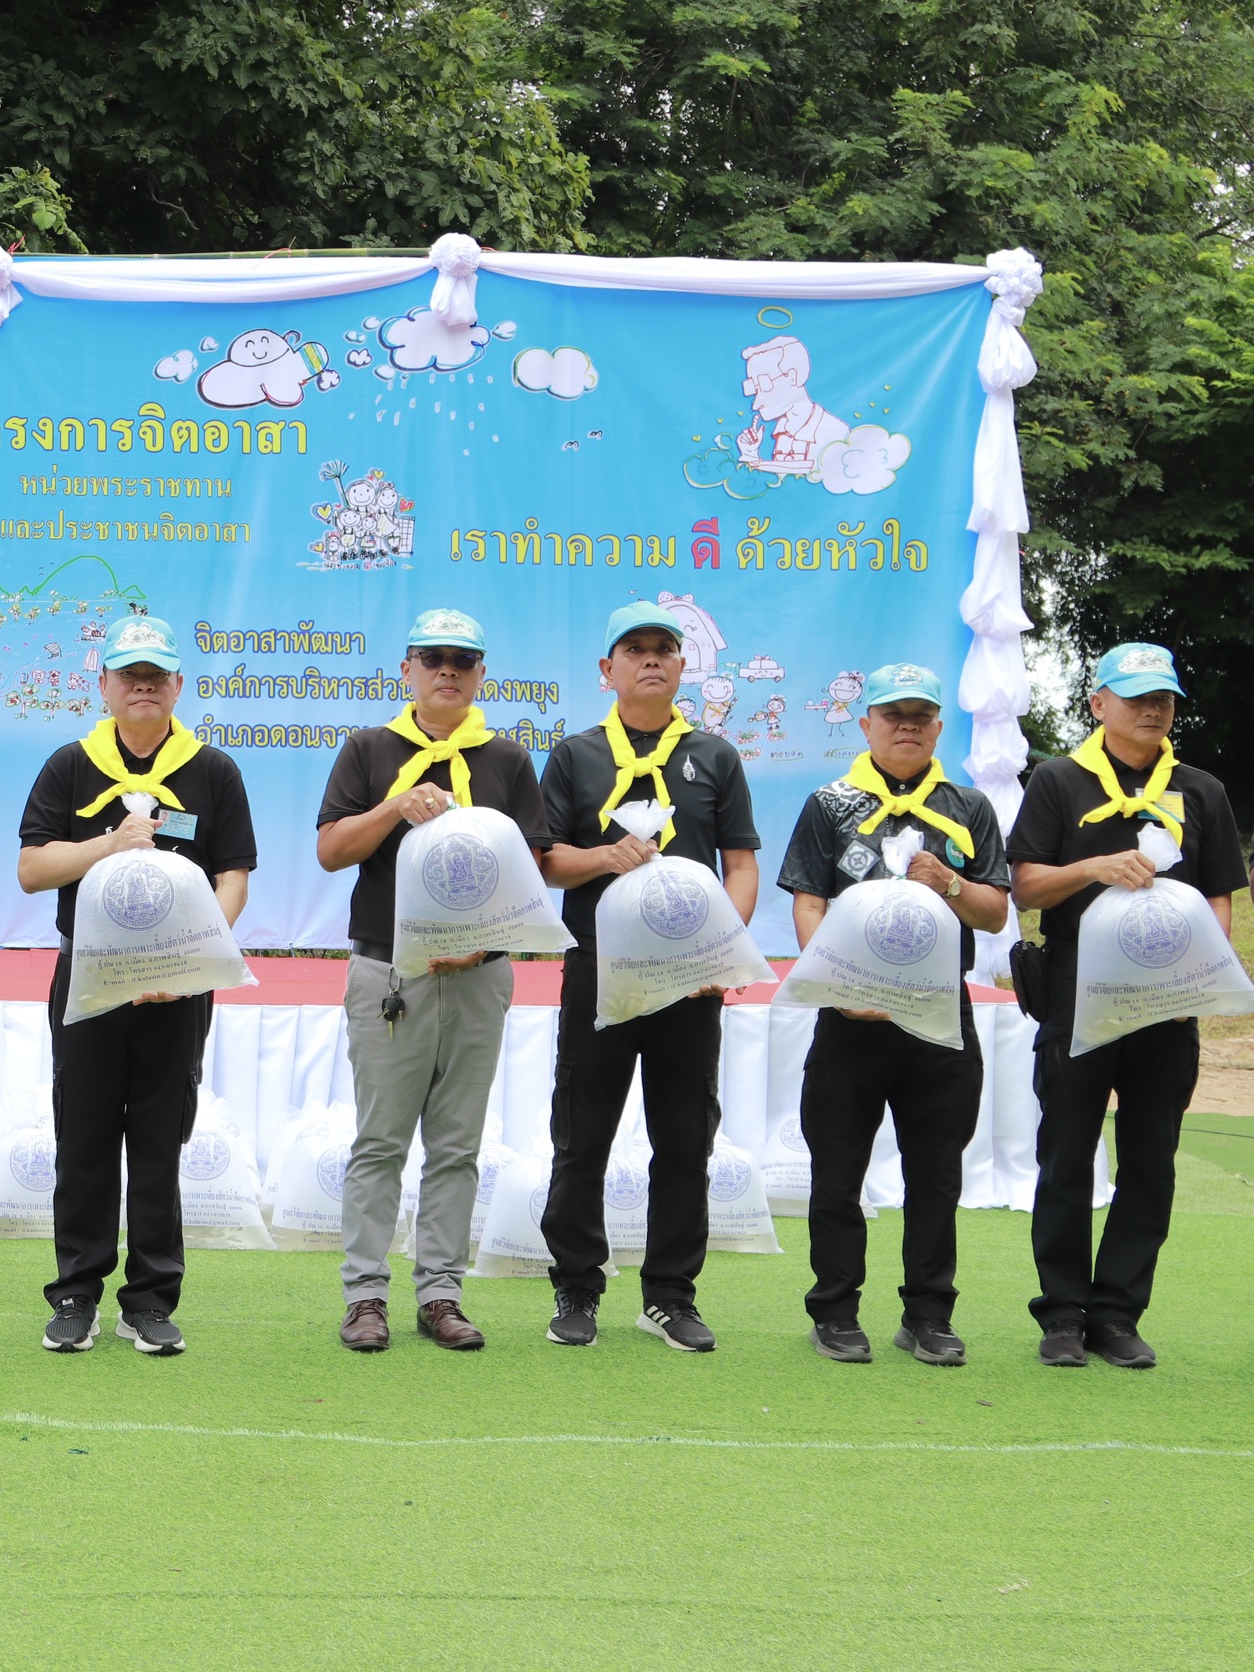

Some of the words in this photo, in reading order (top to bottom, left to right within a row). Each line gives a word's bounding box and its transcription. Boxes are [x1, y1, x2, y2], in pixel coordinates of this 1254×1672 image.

[19, 464, 233, 498] หน่วยพระราชทาน
[0, 509, 251, 543] และประชาชนจิตอาสา
[449, 517, 677, 568] เราทำความ
[690, 516, 721, 570] ดี
[736, 516, 929, 573] ด้วยหัวใจ
[195, 621, 365, 654] จิตอาสาพัฒนา
[195, 715, 368, 749] อำเภอดอนจา
